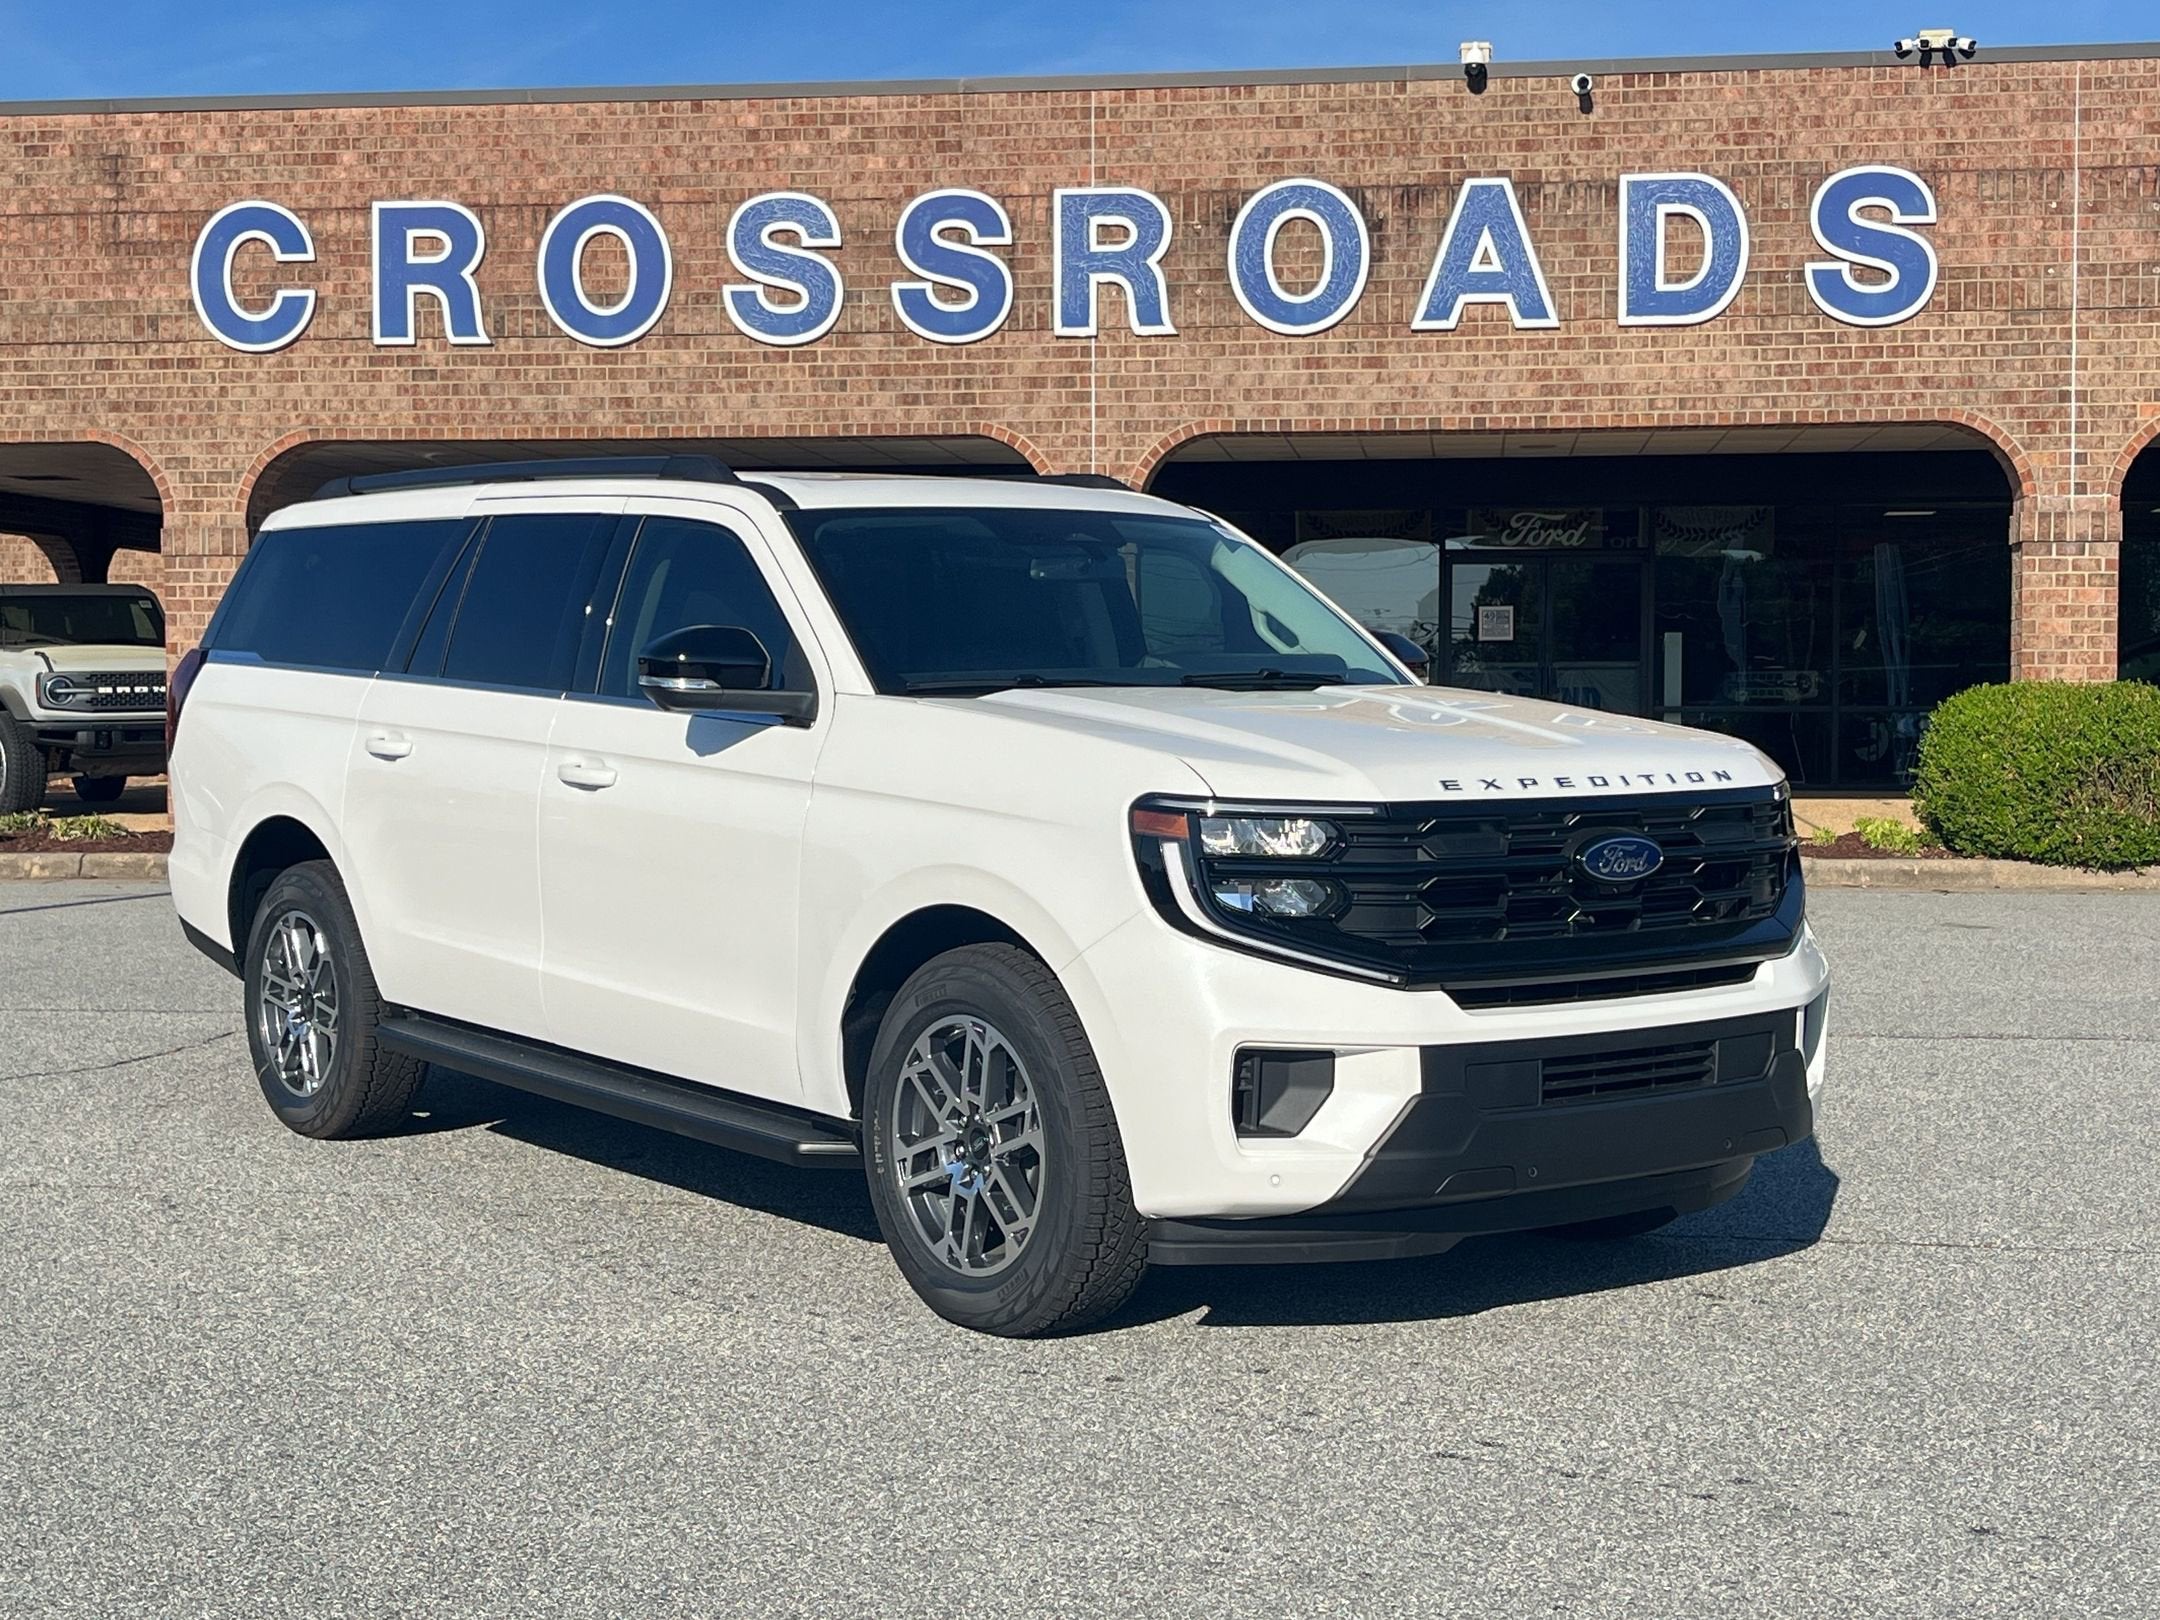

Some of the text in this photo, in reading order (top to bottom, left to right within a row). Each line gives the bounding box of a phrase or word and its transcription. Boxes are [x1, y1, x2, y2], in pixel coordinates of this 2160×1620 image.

[191, 164, 1938, 353] CROSSROADS
[1501, 512, 1589, 547] Ford
[1439, 769, 1732, 792] EXPEDITION
[1599, 844, 1649, 874] Ford
